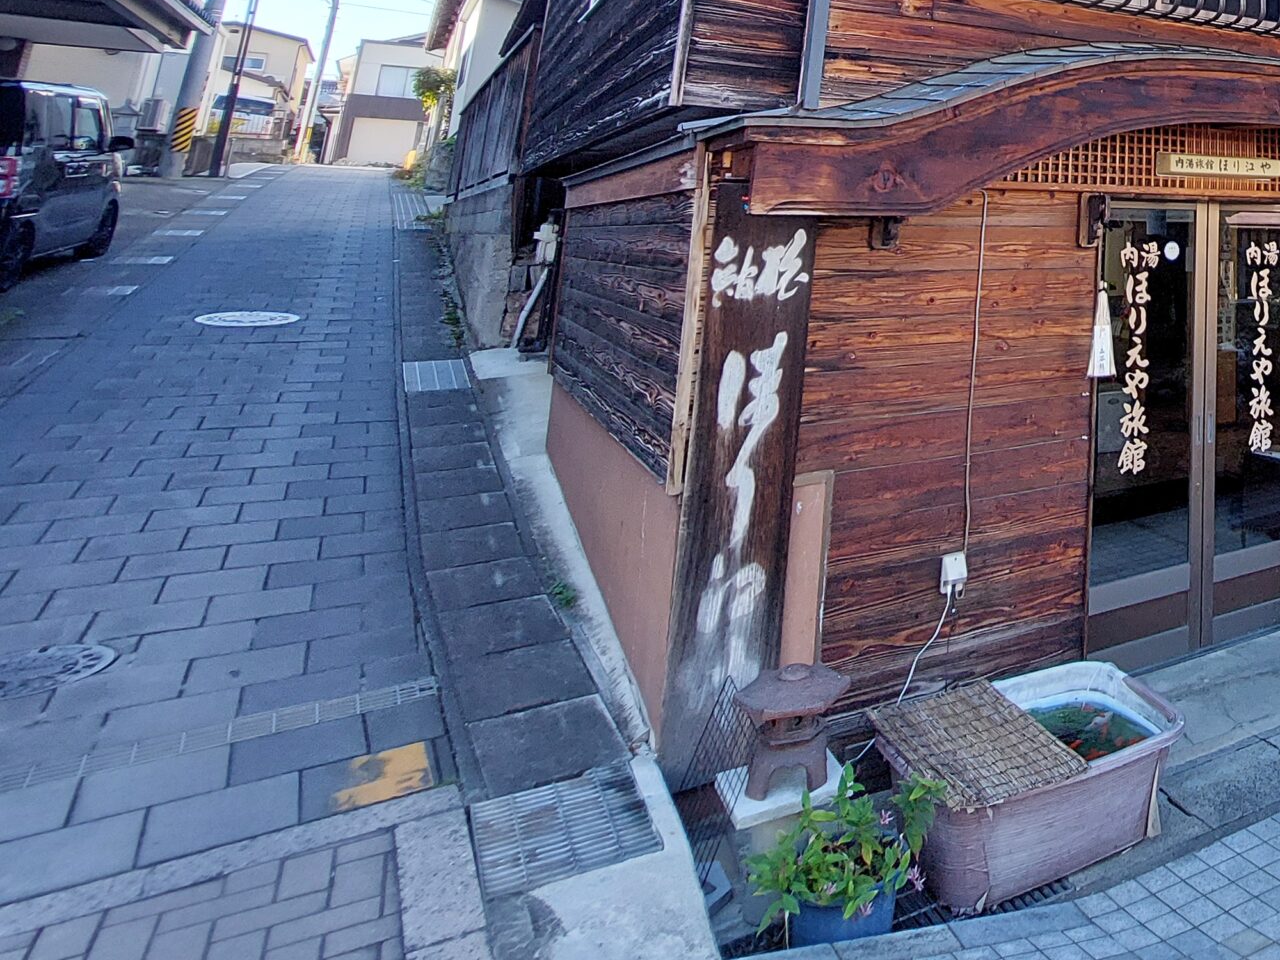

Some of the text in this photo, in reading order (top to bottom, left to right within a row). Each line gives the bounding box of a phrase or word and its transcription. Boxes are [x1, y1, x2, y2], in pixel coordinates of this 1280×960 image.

[1120, 241, 1161, 268] 内湯
[1246, 241, 1279, 267] 内湯
[1117, 271, 1151, 475] ほりえや旅館
[1248, 270, 1274, 453] ほりえや旅館
